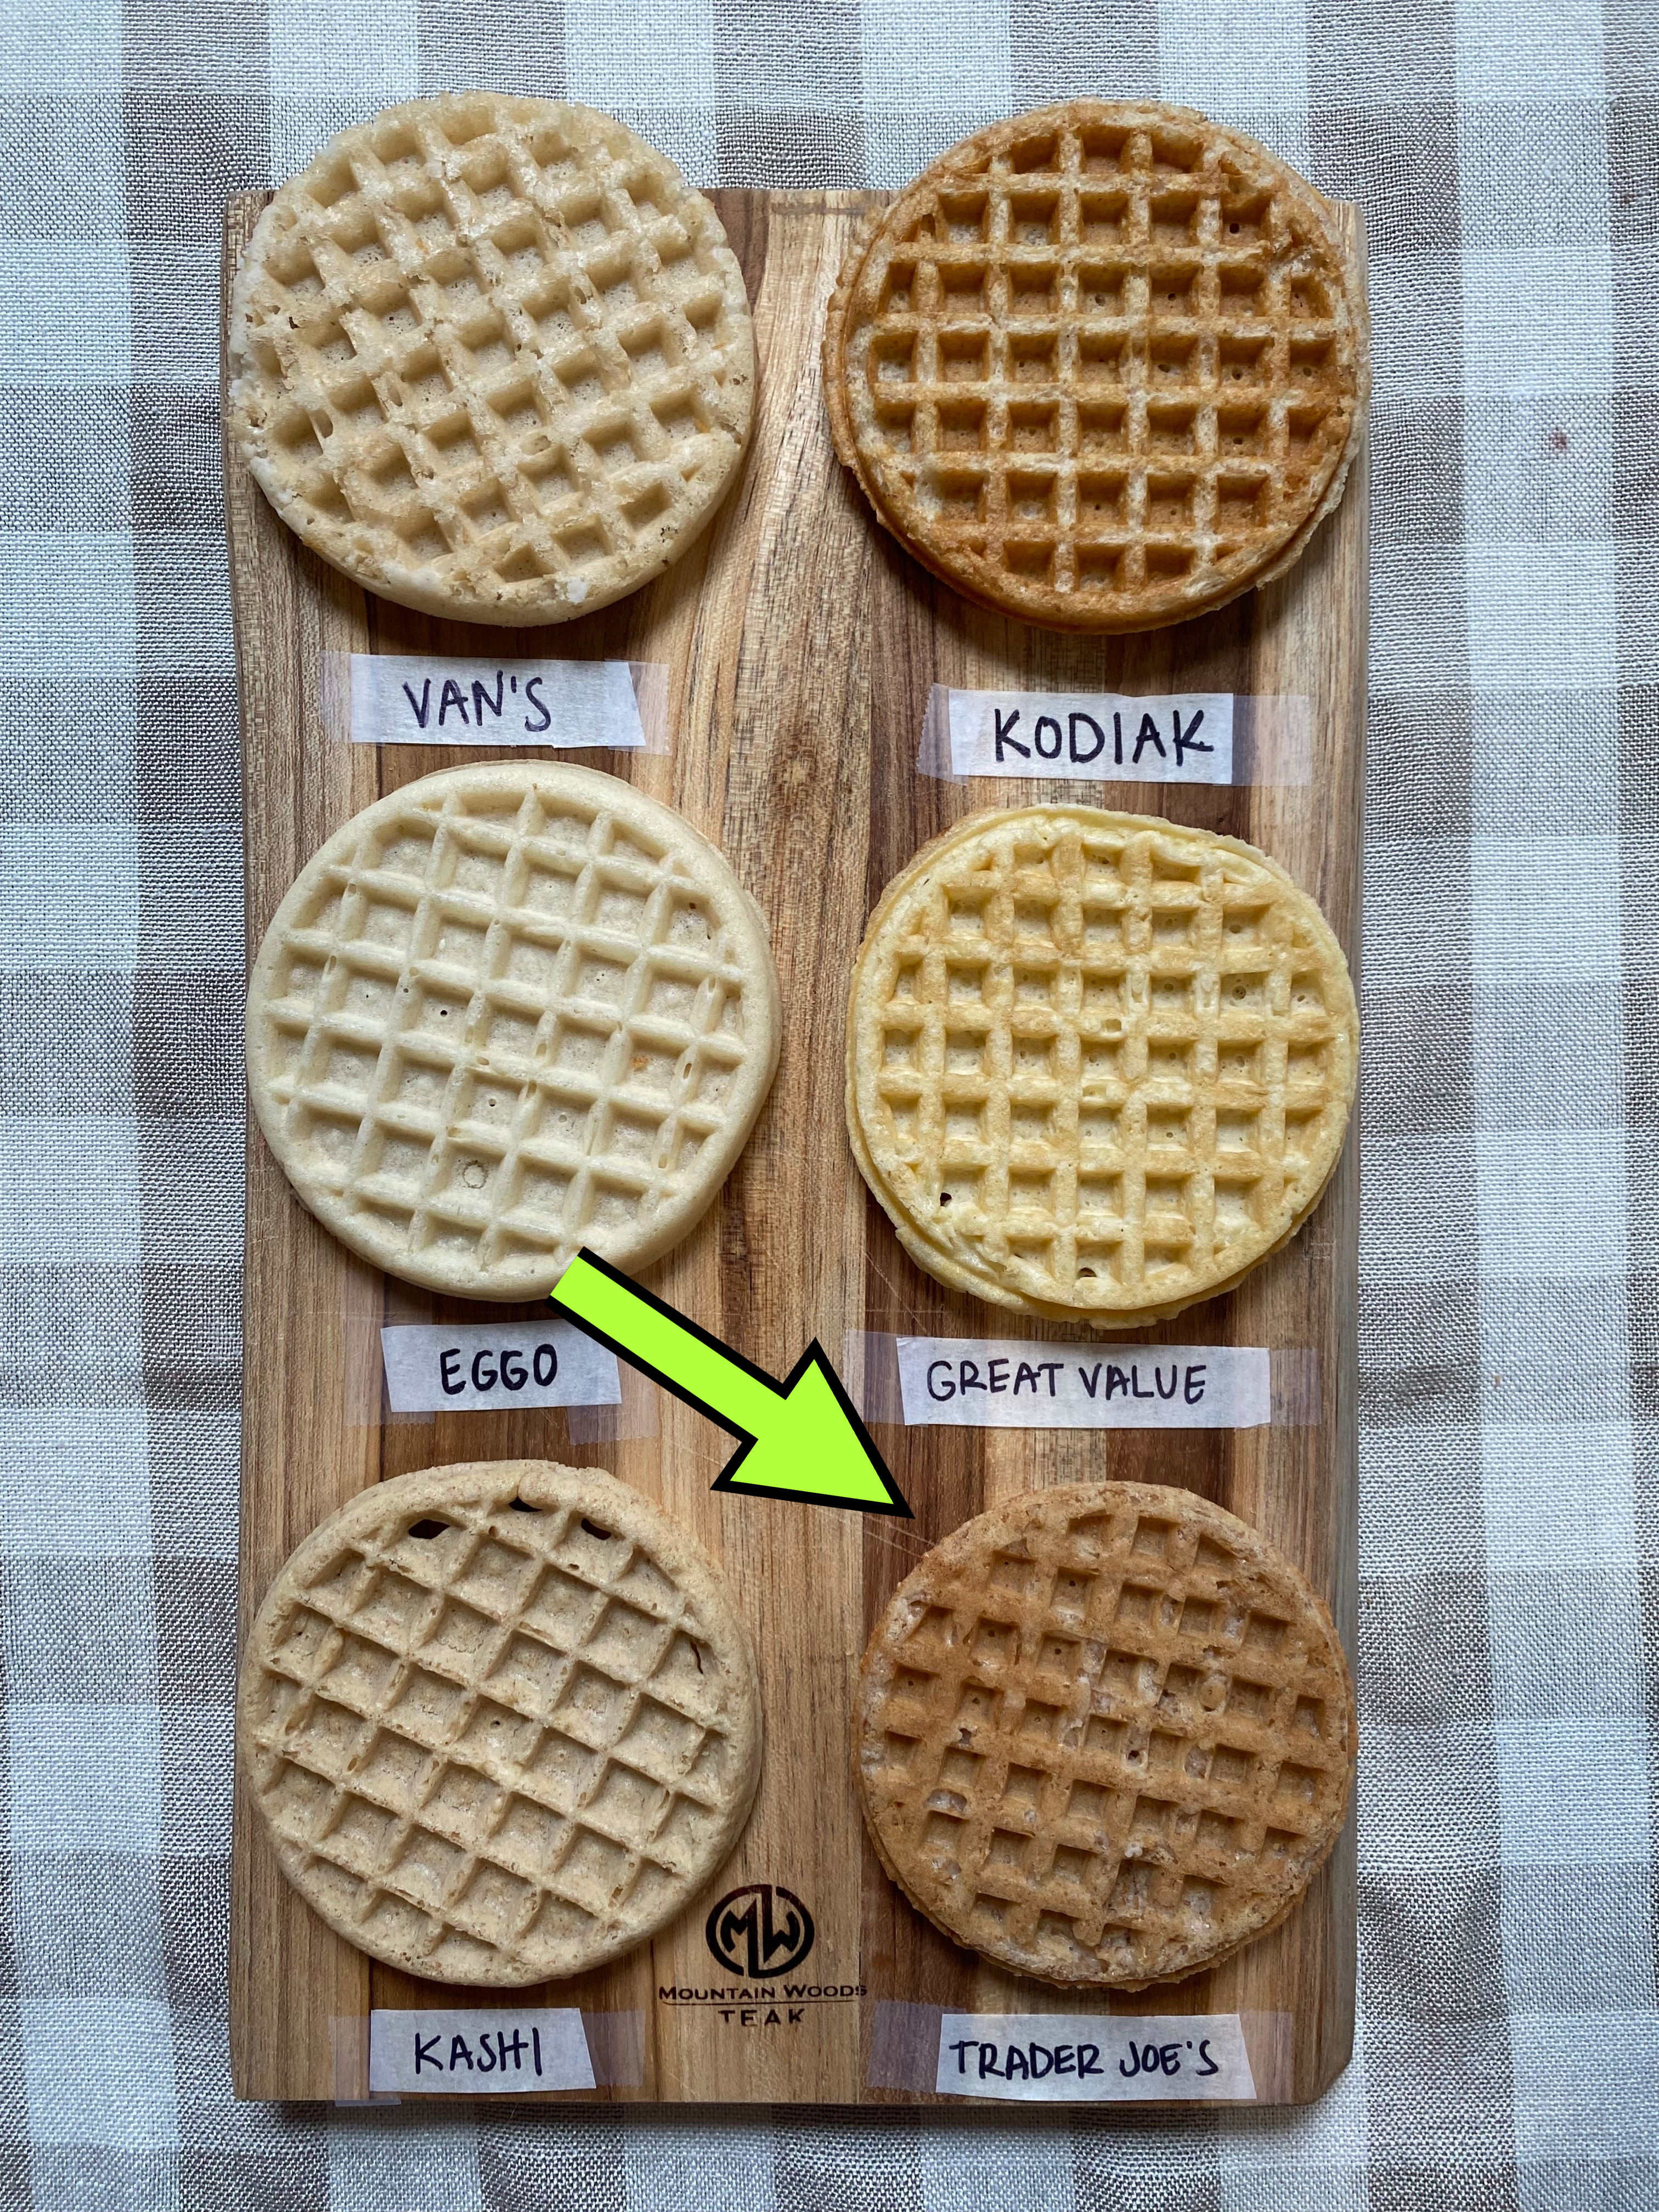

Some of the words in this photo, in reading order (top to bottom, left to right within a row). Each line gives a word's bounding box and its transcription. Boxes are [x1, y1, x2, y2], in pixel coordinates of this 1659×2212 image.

[402, 669, 551, 732] VAN'S
[994, 708, 1215, 766] KODIAK
[440, 1344, 557, 1395] EGGO
[927, 1358, 1064, 1401] GREAT
[1078, 1363, 1207, 1404] VALUE
[718, 2008, 805, 2027] TEAK
[415, 2027, 542, 2076] KASHI
[949, 2040, 1103, 2080] TRADER
[1120, 2040, 1219, 2077] JOE'S
